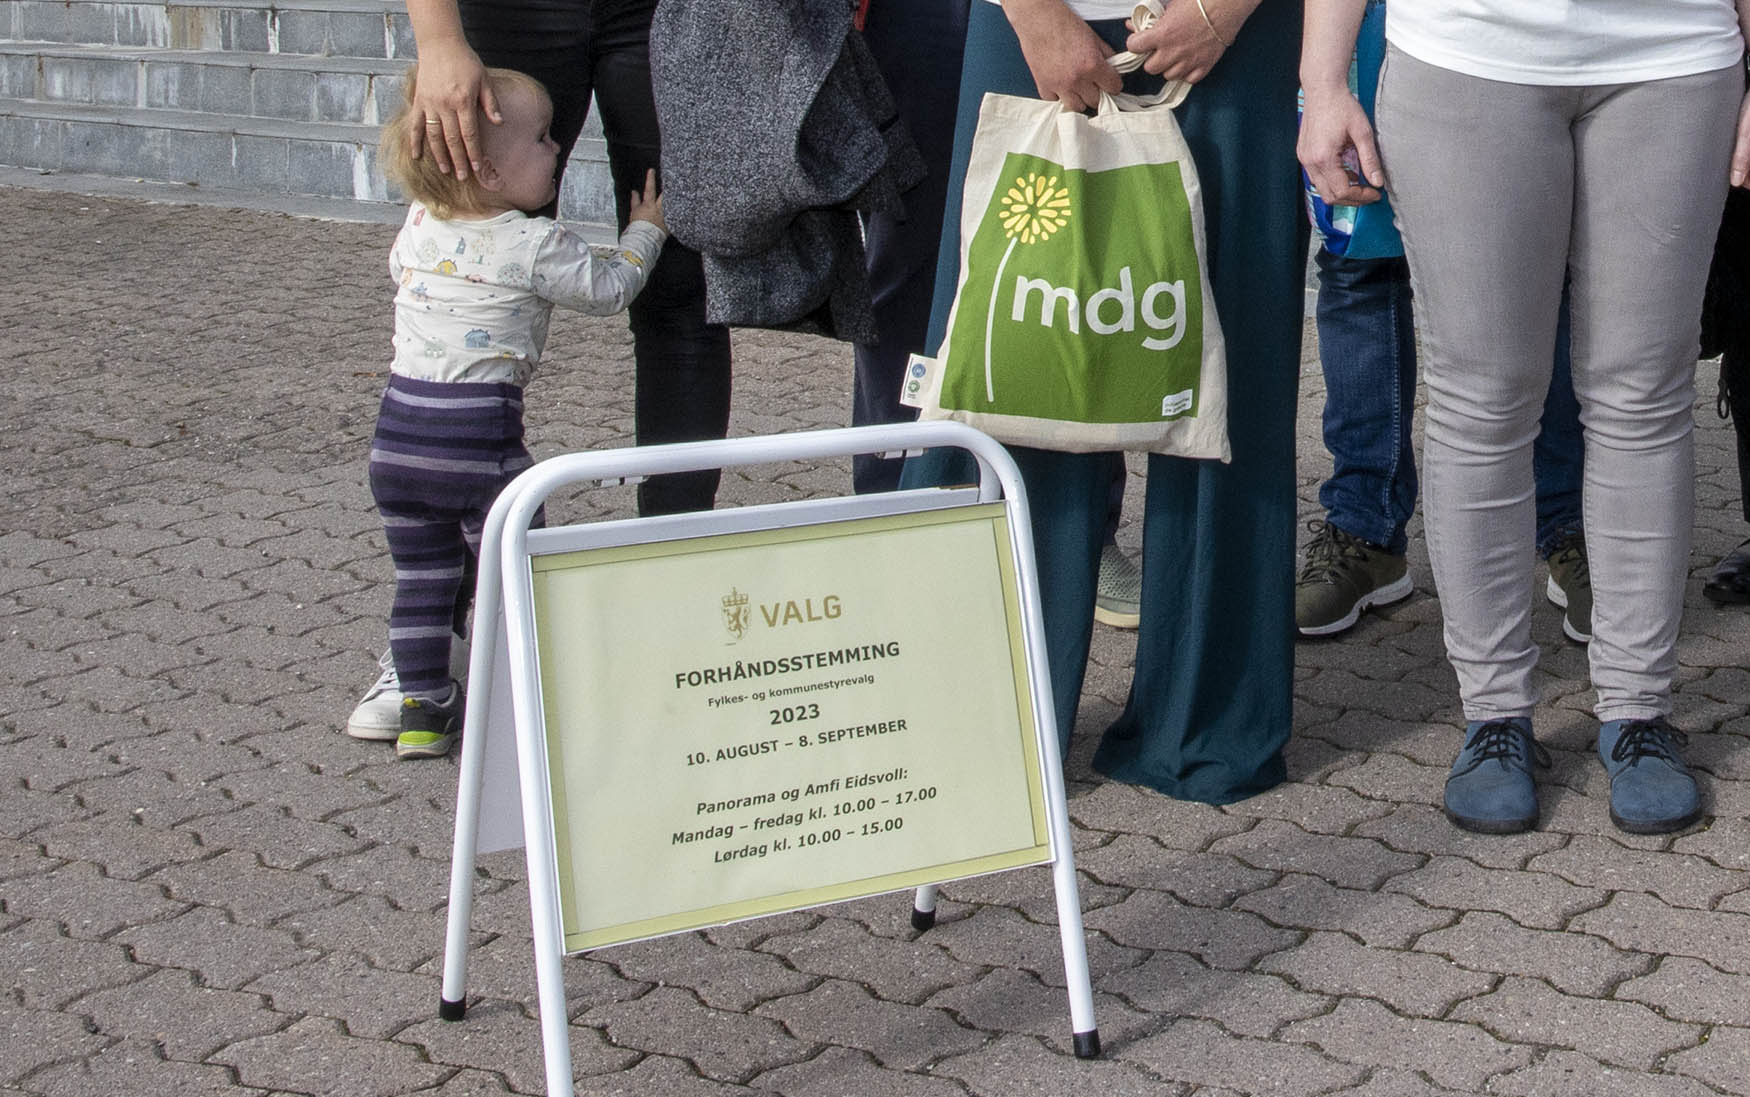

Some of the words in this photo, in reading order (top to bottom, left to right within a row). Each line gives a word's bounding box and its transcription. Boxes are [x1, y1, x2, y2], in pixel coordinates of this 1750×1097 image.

[1011, 266, 1187, 351] mdg
[759, 594, 842, 629] VALG
[675, 641, 900, 689] FORHÅNDSSTEMMING
[707, 692, 750, 708] Fylkes-
[752, 690, 767, 702] og
[769, 672, 875, 699] kommunestyrevalg
[769, 703, 821, 726] 2023
[686, 751, 711, 767] 10.
[715, 739, 779, 762] AUGUST
[798, 734, 814, 748] 8.
[817, 718, 908, 746] SEPTEMBER
[696, 792, 776, 816] Panorama
[780, 787, 800, 803] og
[804, 778, 841, 797] Amfi
[844, 767, 909, 790] Eidsvoll:
[671, 825, 734, 846] Mandag
[753, 812, 804, 832] fredag
[808, 806, 827, 821] kl.
[833, 797, 876, 817] 10.00
[895, 786, 937, 806] 17.00
[714, 844, 768, 864] Lørdag
[773, 837, 792, 853] kl.
[797, 828, 842, 848] 10.00
[861, 816, 904, 835] 15.00
